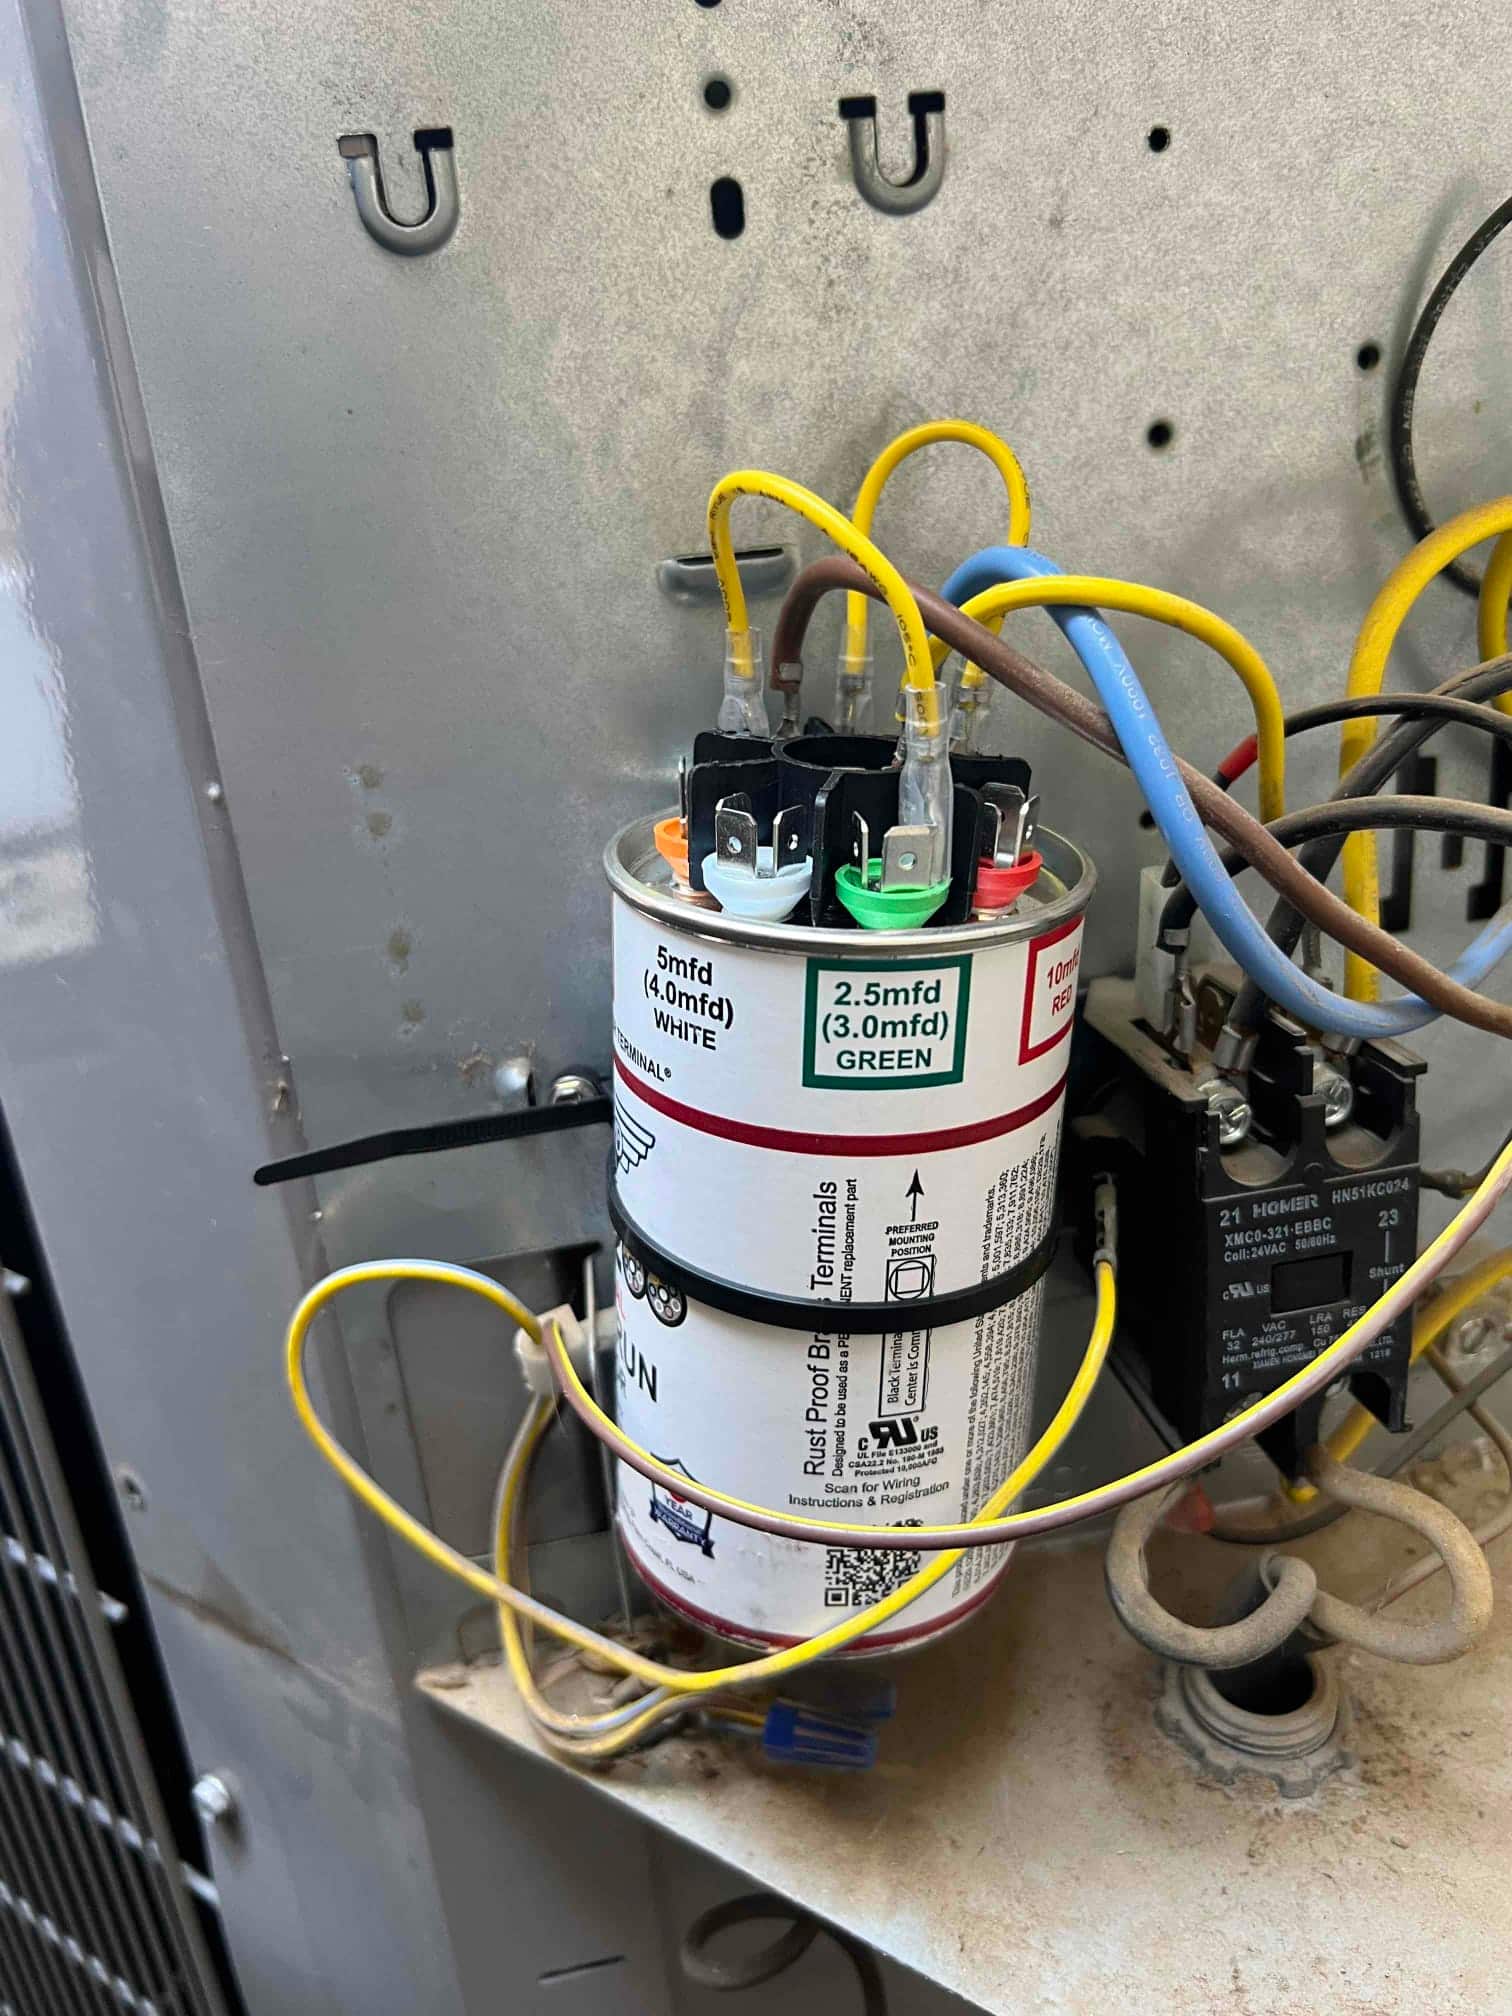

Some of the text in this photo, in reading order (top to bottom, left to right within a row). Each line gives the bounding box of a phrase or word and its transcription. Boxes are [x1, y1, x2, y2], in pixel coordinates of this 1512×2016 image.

[657, 945, 712, 986] 5mfd
[644, 969, 734, 1029] (4.0mfd)
[834, 979, 941, 1006] 2.5mfd
[1052, 984, 1073, 1016] RED
[654, 1008, 716, 1050] WHITE
[822, 1011, 949, 1043] (3.0mfd)
[836, 1048, 932, 1070] GREEN
[845, 1178, 859, 1201] part
[1332, 1177, 1410, 1204] HN51KC024
[983, 1184, 996, 1242] trademarks.
[1219, 1194, 1319, 1227] 21 HOMER
[1378, 1209, 1400, 1227] 23
[810, 1181, 837, 1290] Terminals
[841, 1203, 856, 1271] replacement
[886, 1221, 939, 1235] PREFERRED
[889, 1233, 935, 1246] MOUNTING
[891, 1244, 932, 1257] POSITION
[982, 1243, 990, 1261] and
[1368, 1263, 1405, 1279] Shunt
[1222, 1328, 1245, 1341] FLA
[1261, 1320, 1287, 1333] VAC
[1309, 1312, 1333, 1325] LRA
[1251, 1330, 1296, 1346] 240/277
[838, 1350, 848, 1358] a
[838, 1359, 848, 1373] as
[806, 1364, 829, 1423] Proof
[836, 1375, 847, 1400] used
[887, 1376, 900, 1404] Black
[905, 1373, 918, 1406] Center
[1221, 1373, 1241, 1390] 11
[834, 1402, 846, 1416] be
[834, 1418, 846, 1429] to
[804, 1429, 826, 1476] Rust
[832, 1430, 846, 1477] Designed
[855, 1466, 894, 1477] Protected
[789, 1480, 949, 1508] Instructions & Registration
[824, 1476, 921, 1494] Scan for Wiring
[665, 1496, 693, 1520] YEAR
